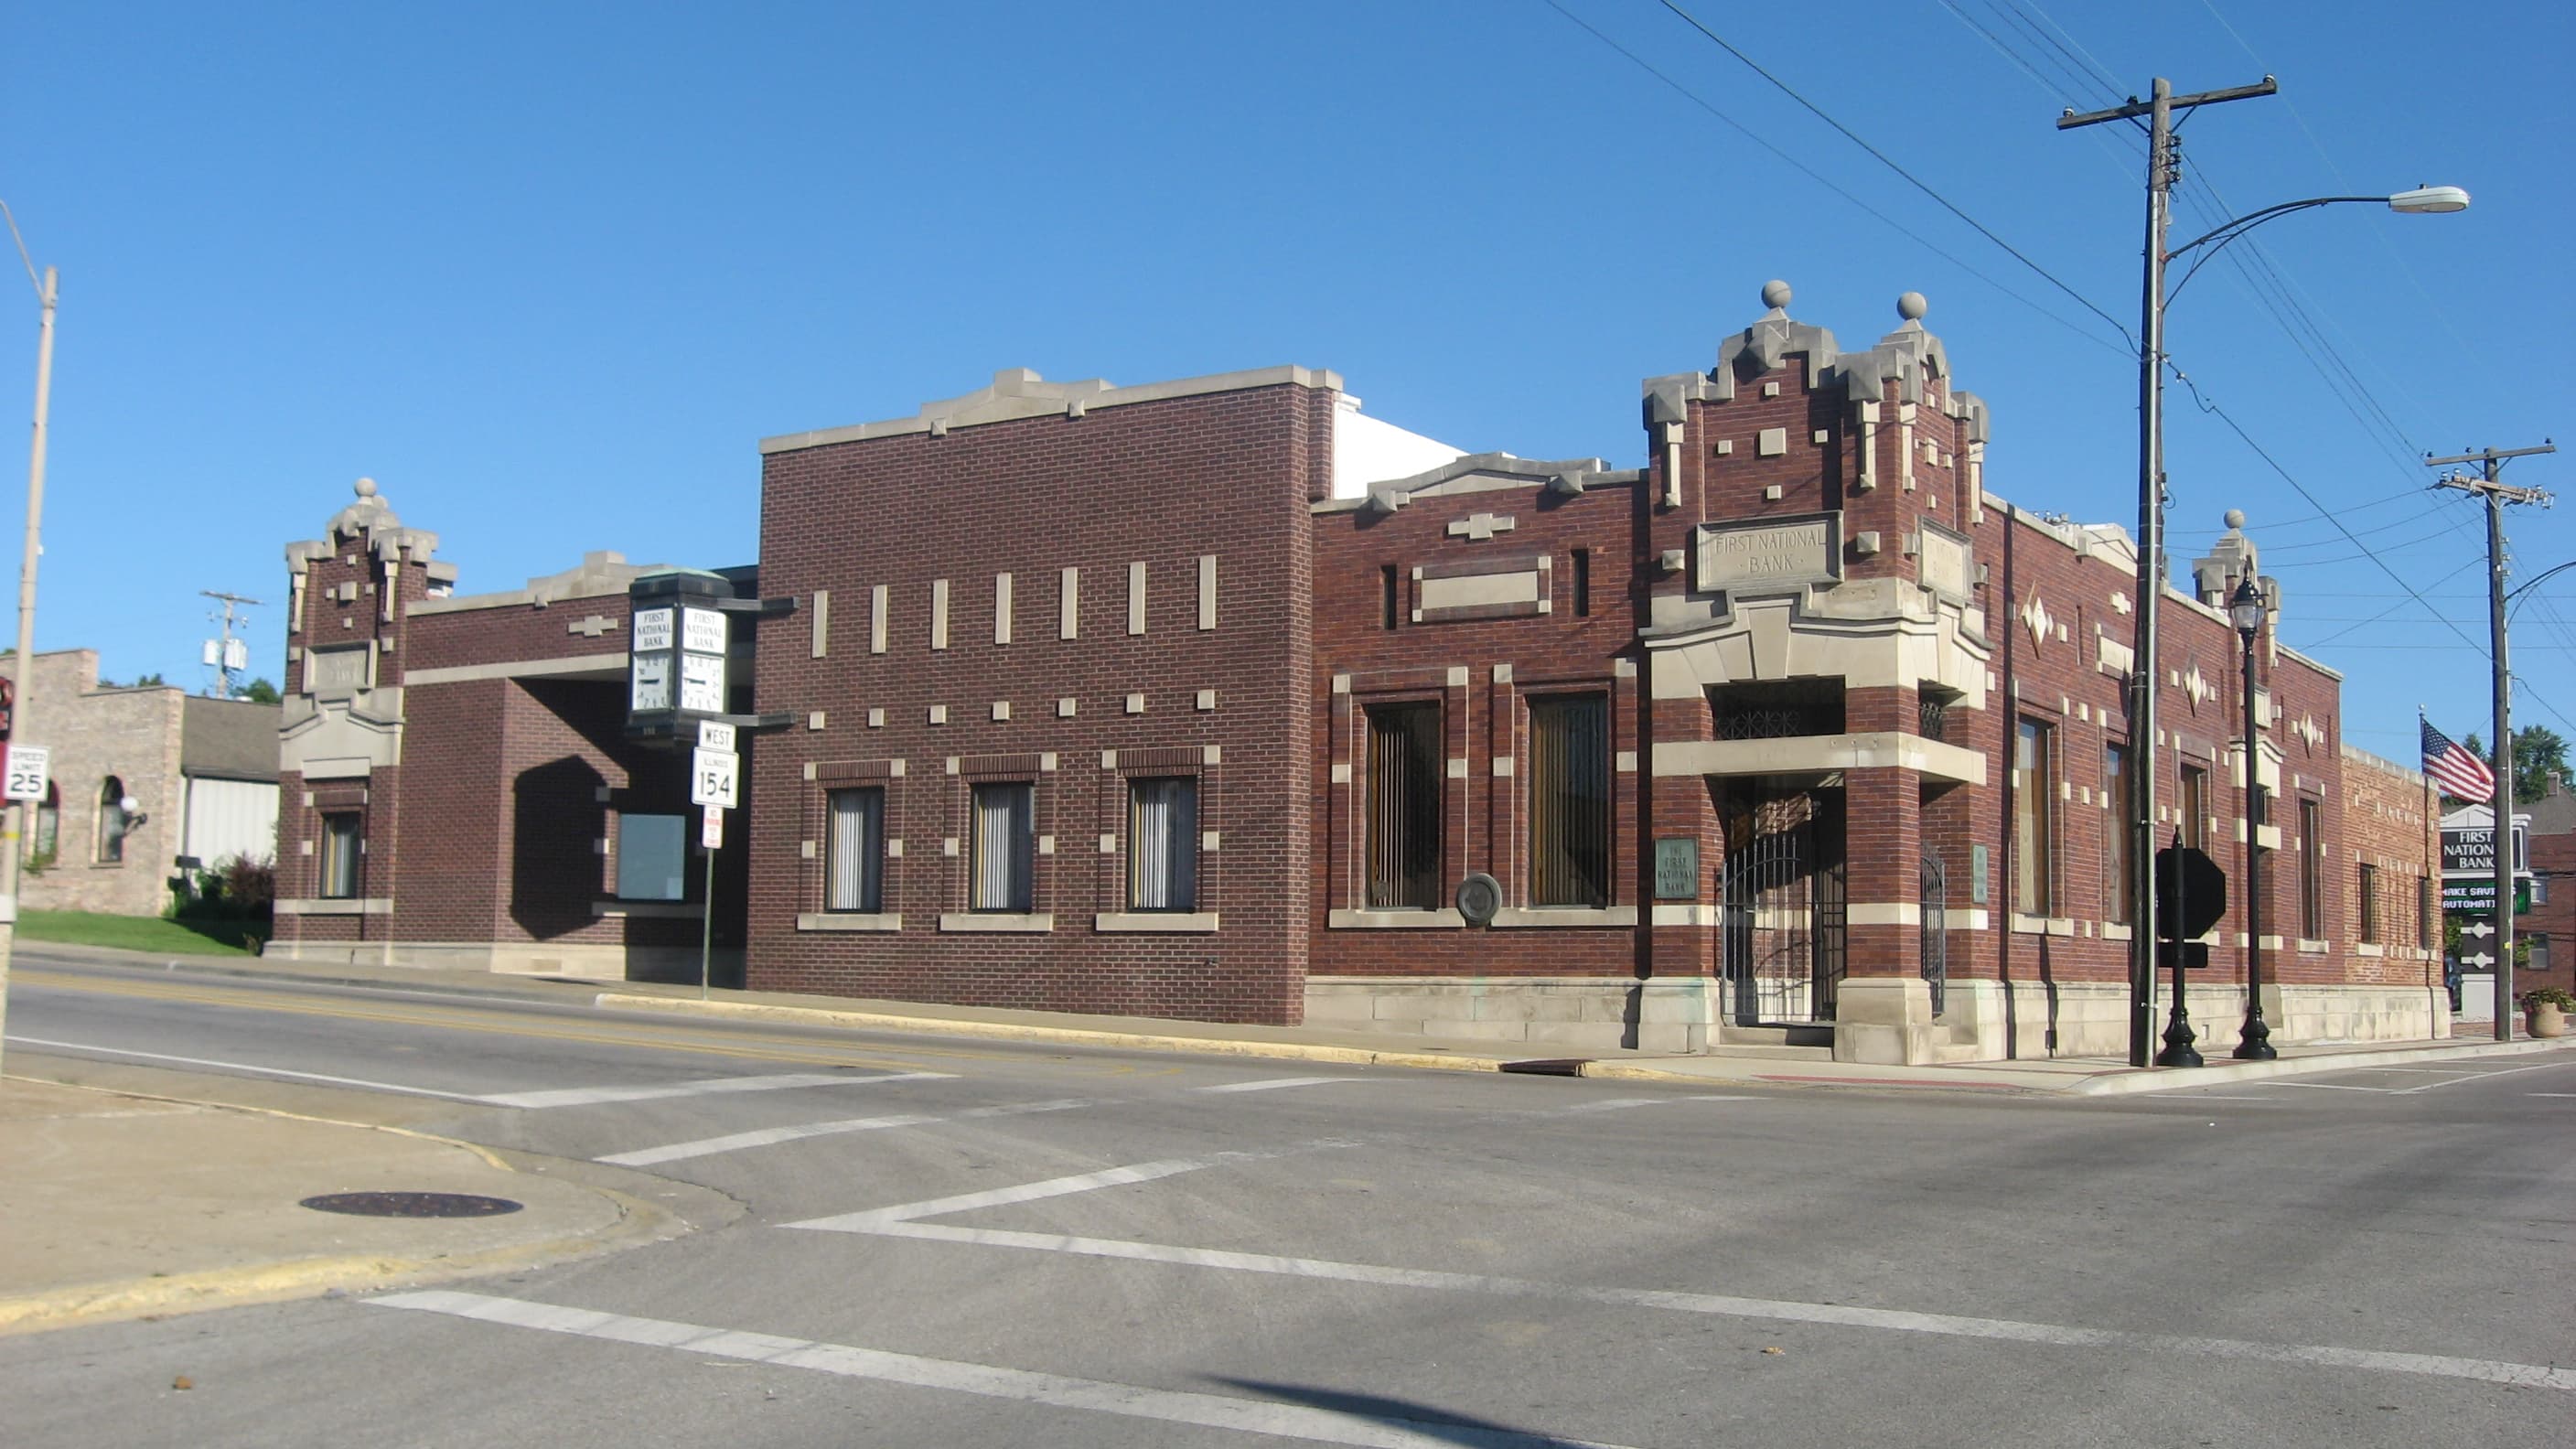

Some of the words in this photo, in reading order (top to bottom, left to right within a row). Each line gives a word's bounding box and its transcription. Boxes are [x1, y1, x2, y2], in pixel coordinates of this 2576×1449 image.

[1715, 535, 1755, 553] FIRST
[1757, 529, 1827, 549] NATIONAL
[1748, 555, 1793, 573] BANK
[644, 613, 665, 623] FIRST
[694, 613, 715, 624] FIRST
[637, 623, 671, 635] NATIONAL
[686, 624, 722, 638] NATIONAL
[643, 636, 663, 647] BANK
[693, 637, 714, 649] BANK
[705, 728, 730, 746] WEST
[12, 751, 45, 762] SPEED
[14, 762, 41, 771] LIMIT
[10, 773, 41, 793] 25
[700, 771, 730, 798] 154
[2459, 832, 2494, 843] FIRST
[2443, 843, 2495, 856] NATION
[2459, 857, 2496, 868] BANK
[2442, 899, 2496, 908] AUTOMATI
